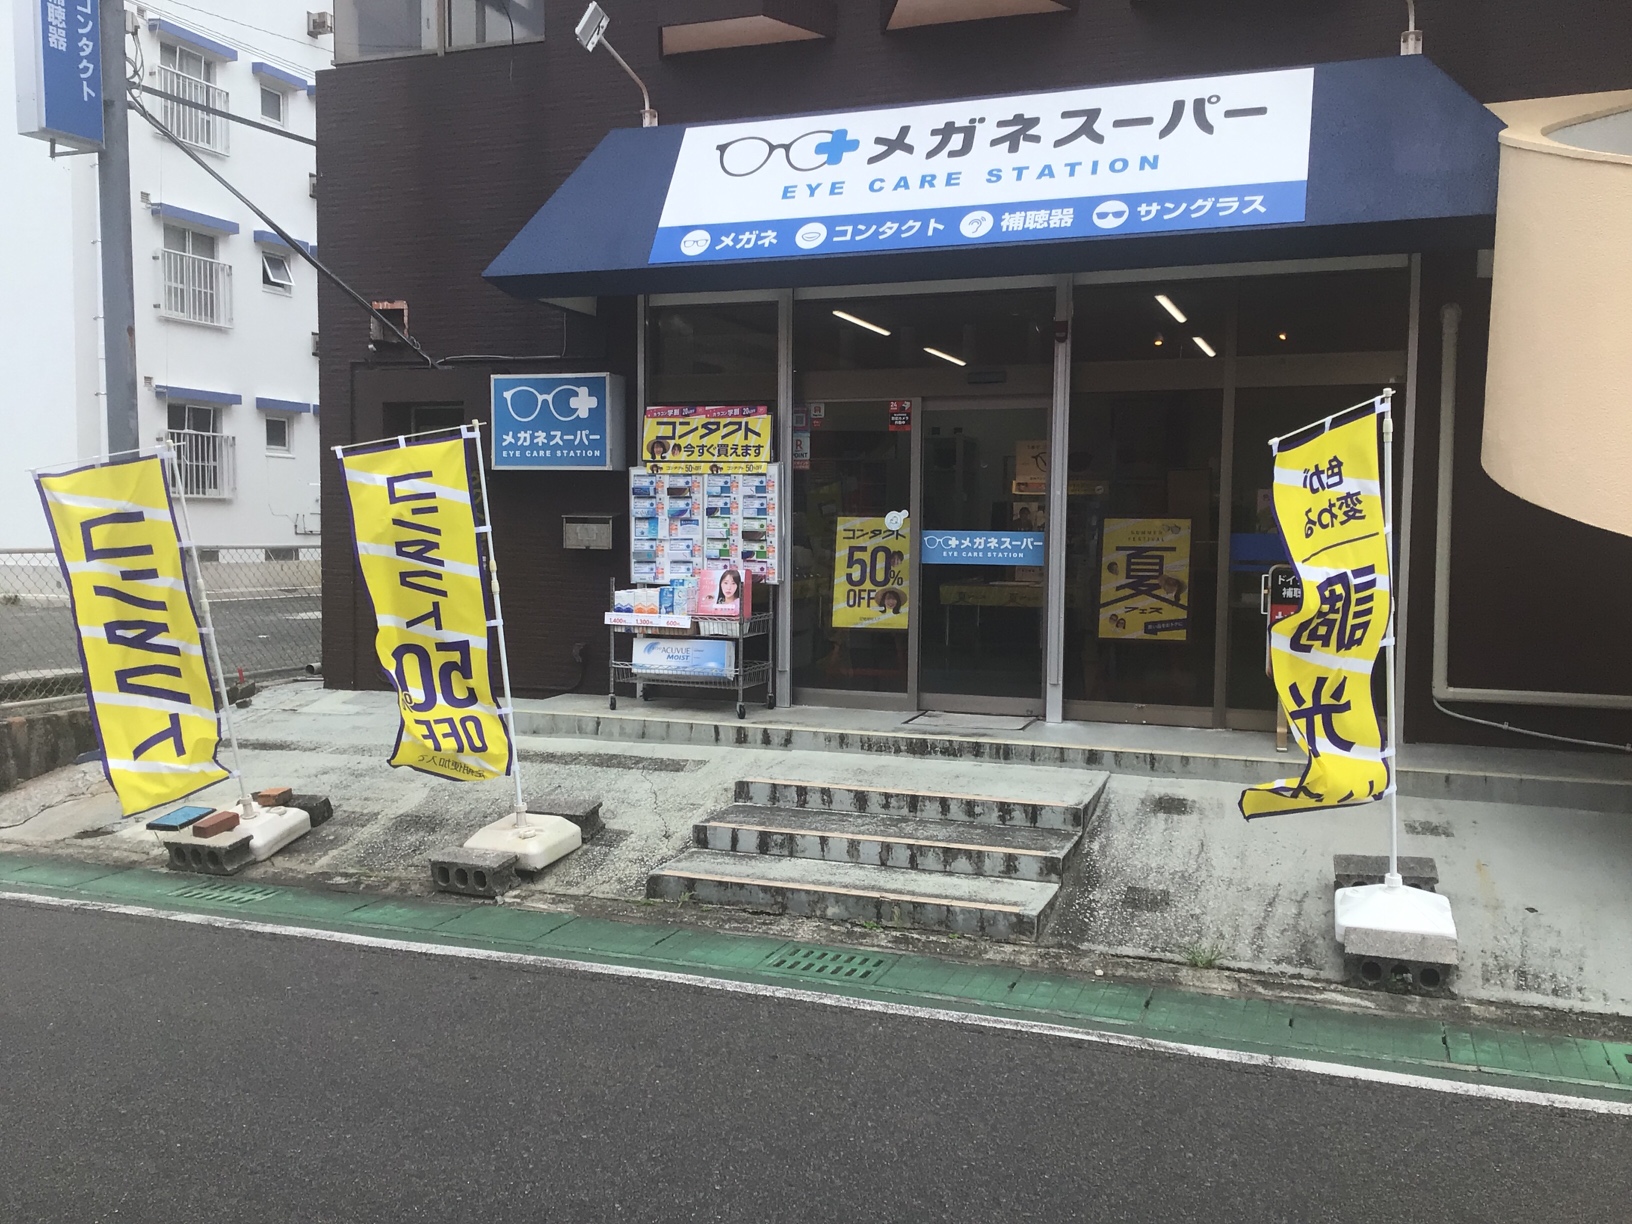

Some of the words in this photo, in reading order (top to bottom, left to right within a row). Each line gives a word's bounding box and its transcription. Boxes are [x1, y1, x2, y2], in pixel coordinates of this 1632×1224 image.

[47, 0, 67, 52] 聴器
[866, 94, 1268, 166] メガネスーパー
[781, 181, 846, 200] EYE
[868, 171, 962, 193] CARE
[985, 154, 1160, 184] STATION
[1137, 194, 1268, 223] サングラス
[1000, 207, 1075, 233] 補聴器
[715, 229, 778, 250] メガネ
[832, 218, 945, 243] コンタクト
[502, 429, 601, 447] メガネスーパー
[655, 421, 762, 440] コンタクト
[556, 449, 600, 457] STATION
[682, 442, 765, 458] 今すぐ買えます
[842, 528, 907, 541] コンタクト
[960, 537, 1043, 550] メガネスーパー
[845, 546, 904, 588] 50%
[1099, 545, 1190, 611] 夏
[846, 588, 877, 608] OFF
[1124, 606, 1163, 615] フェス
[661, 646, 691, 655] ACUVUE
